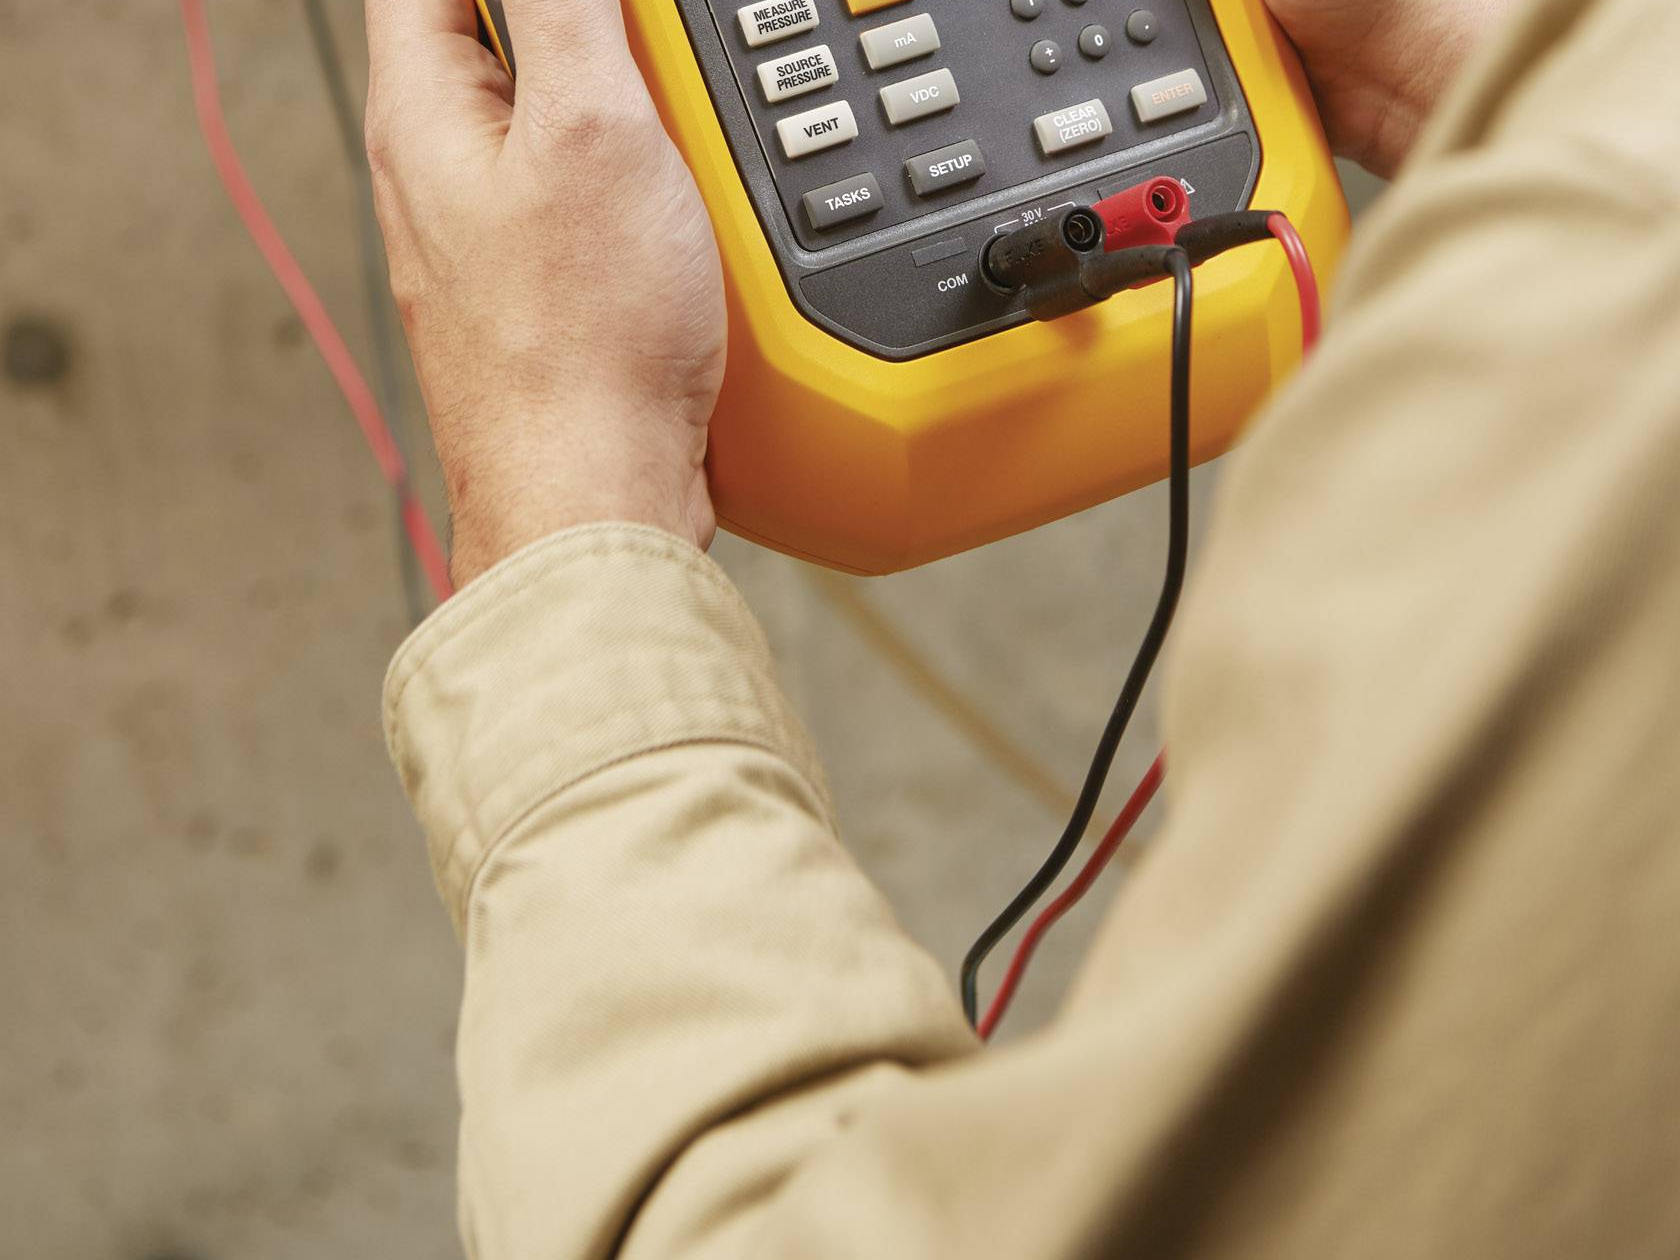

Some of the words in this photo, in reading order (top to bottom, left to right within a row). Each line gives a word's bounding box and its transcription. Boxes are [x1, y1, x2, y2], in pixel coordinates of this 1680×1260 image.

[757, 10, 813, 36] PRESSURE
[894, 31, 917, 47] mA
[1094, 34, 1104, 47] 0
[776, 53, 825, 78] SOURCE
[776, 64, 832, 92] PRESSURE
[909, 85, 940, 105] VDC
[1151, 83, 1195, 106] ENTER
[803, 117, 841, 139] VENT
[1053, 104, 1098, 129] CLEAR
[1059, 117, 1103, 144] (ZERO)
[928, 154, 973, 178] SETUP
[825, 187, 871, 212] TASKS
[937, 272, 969, 293] COM
